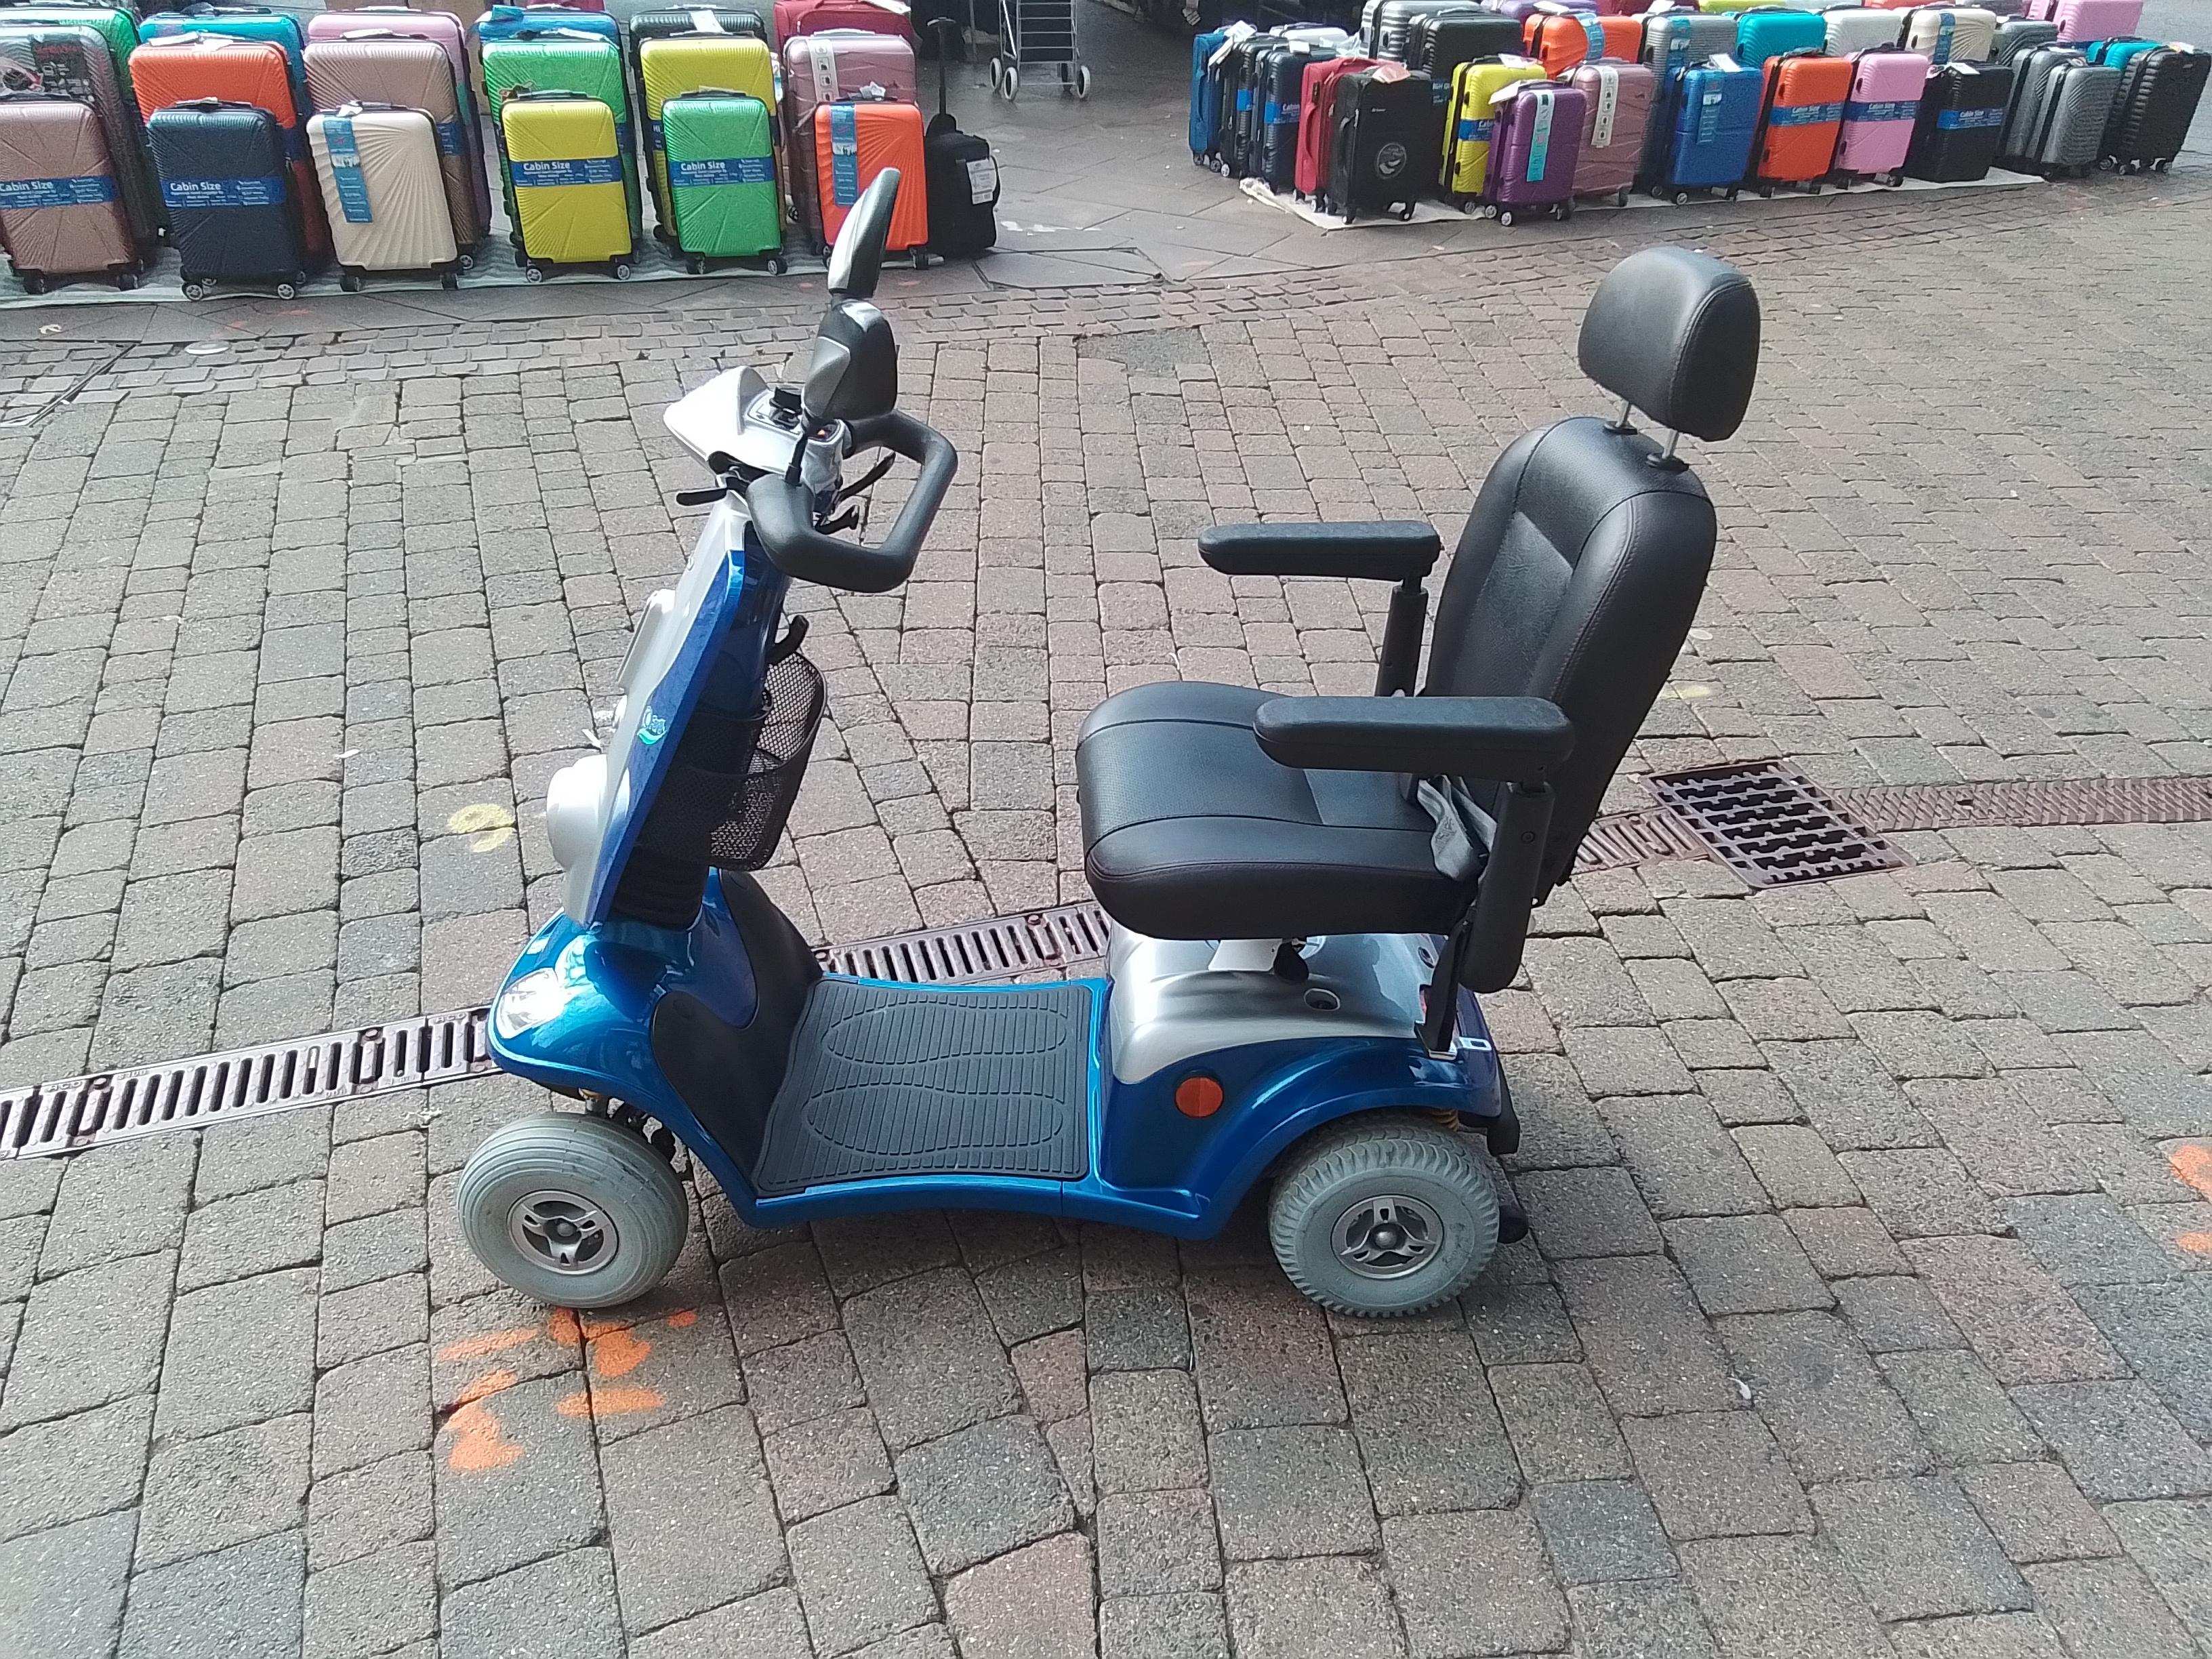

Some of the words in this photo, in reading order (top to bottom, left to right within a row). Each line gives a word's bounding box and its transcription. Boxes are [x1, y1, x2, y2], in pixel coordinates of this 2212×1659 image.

[523, 161, 550, 171] Cabin
[551, 161, 571, 169] Size
[680, 161, 706, 171] Cabin
[707, 161, 726, 169] Size
[0, 182, 30, 192] Cabin
[30, 181, 54, 190] Size
[170, 182, 199, 191] Cabin
[200, 182, 222, 190] Size
[435, 1011, 467, 1024] ACO
[47, 1080, 83, 1092] ACO
